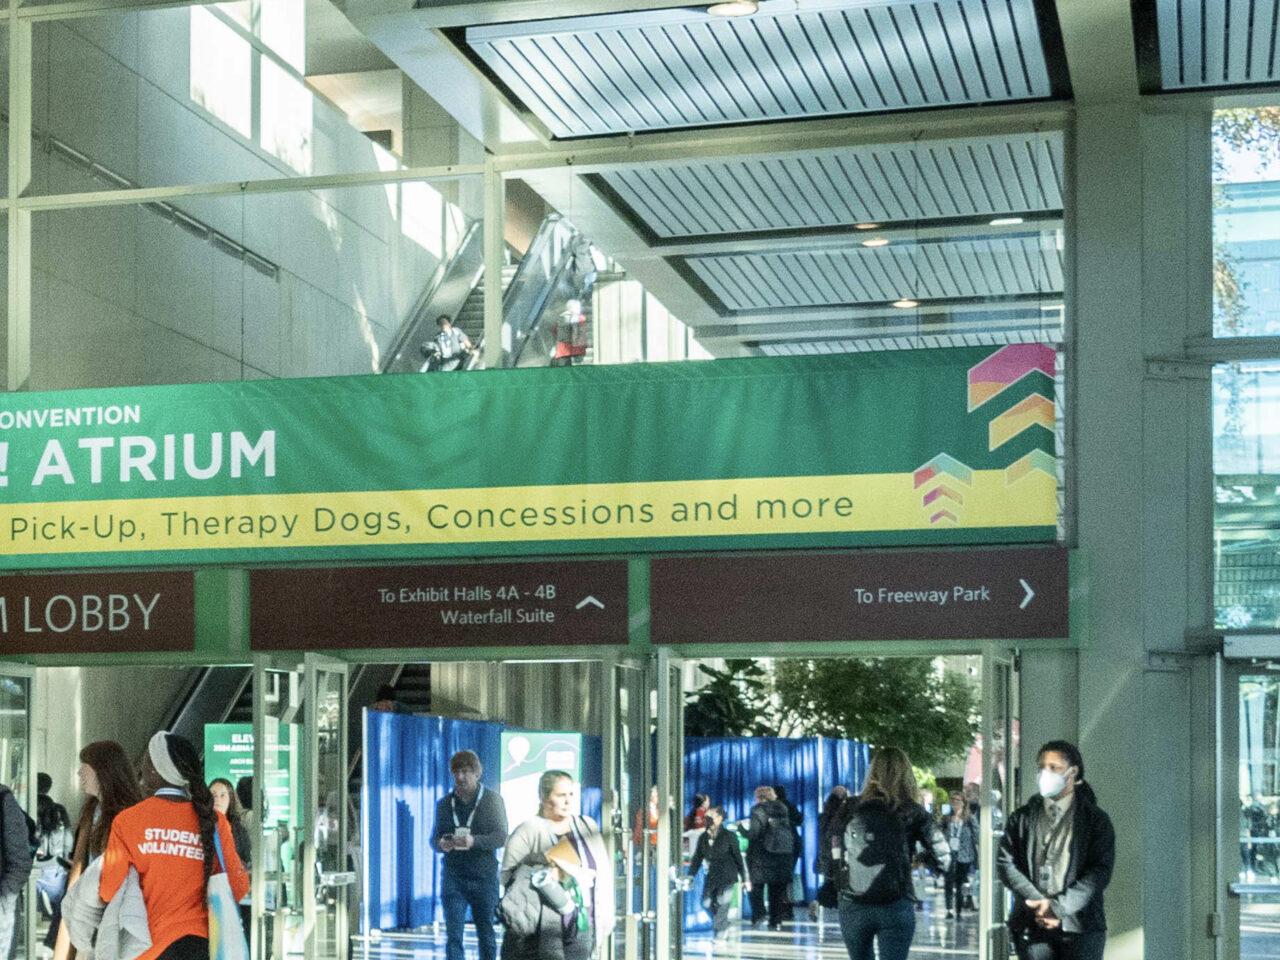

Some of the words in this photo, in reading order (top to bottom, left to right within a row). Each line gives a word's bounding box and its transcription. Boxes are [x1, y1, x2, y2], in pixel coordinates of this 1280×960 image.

[31, 430, 277, 486] ATRIUM
[11, 514, 145, 543] Pick-Up,
[160, 511, 298, 538] Therapy
[314, 507, 411, 536] Dogs,
[427, 498, 655, 530] Concessions
[670, 494, 738, 522] and
[756, 496, 854, 519] more
[378, 588, 396, 603] To
[400, 587, 450, 602] Exhibit
[454, 586, 492, 601] Halls
[496, 585, 519, 600] 4A
[534, 585, 556, 599] 4B
[854, 588, 873, 604] To
[878, 587, 948, 605] Freeway
[953, 585, 990, 601] Park
[23, 593, 162, 633] LOBBY
[440, 608, 512, 625] Waterfall
[516, 608, 555, 624] Suite
[144, 828, 202, 846] STUDEN
[137, 841, 205, 861] VOLUNTEE
